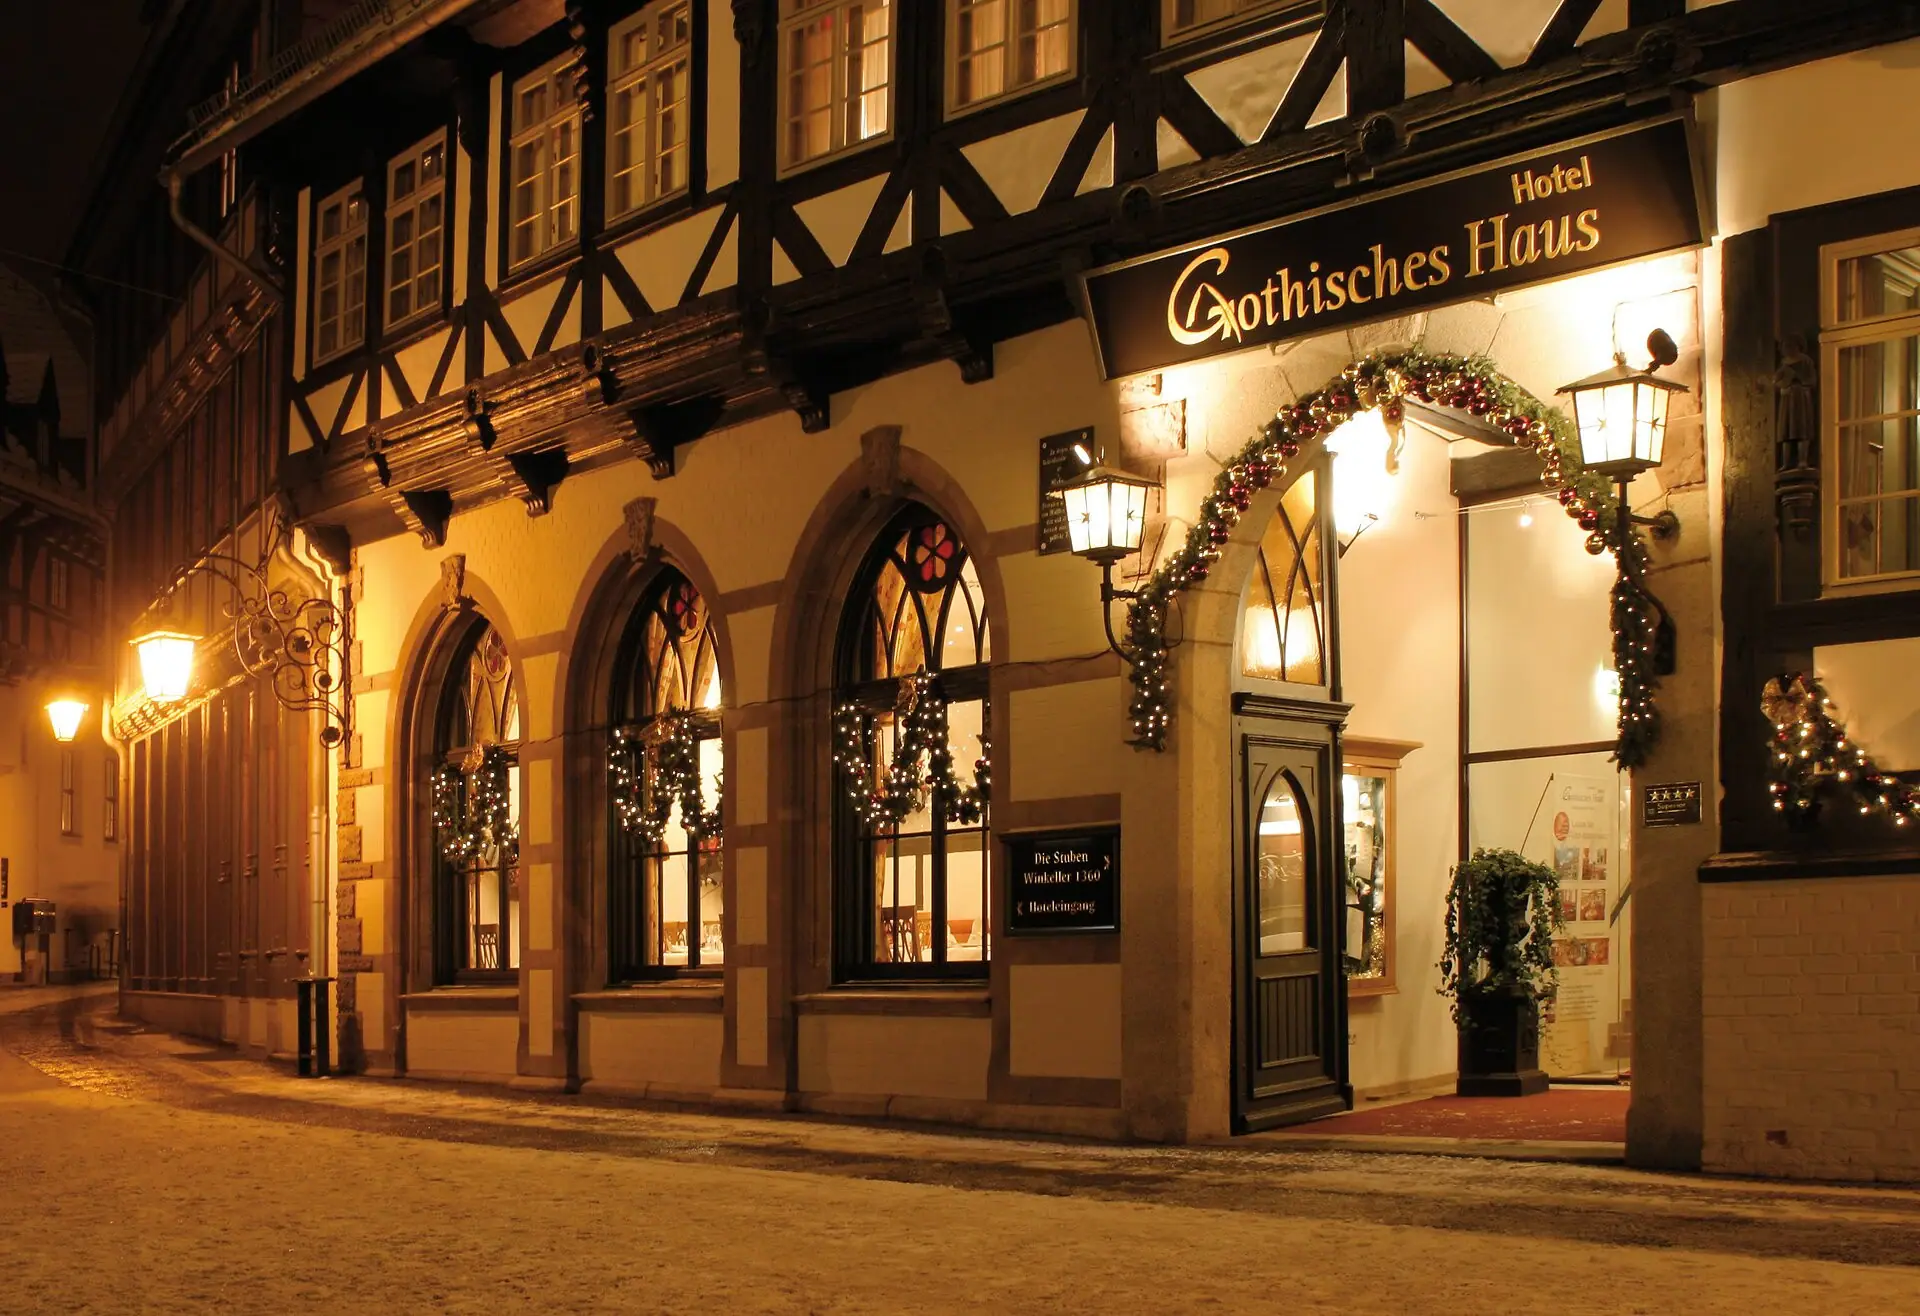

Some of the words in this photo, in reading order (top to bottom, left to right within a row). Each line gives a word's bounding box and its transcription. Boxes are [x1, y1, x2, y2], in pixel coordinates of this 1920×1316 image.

[1510, 155, 1593, 205] Hotel
[1167, 247, 1451, 346] Gothisches
[1464, 207, 1601, 279] Haus
[1034, 851, 1051, 865] Die
[1053, 849, 1089, 864] Stuben
[1023, 870, 1072, 885] Winkeller
[1076, 869, 1101, 882] 1360
[1029, 900, 1096, 915] Hoteleingang
